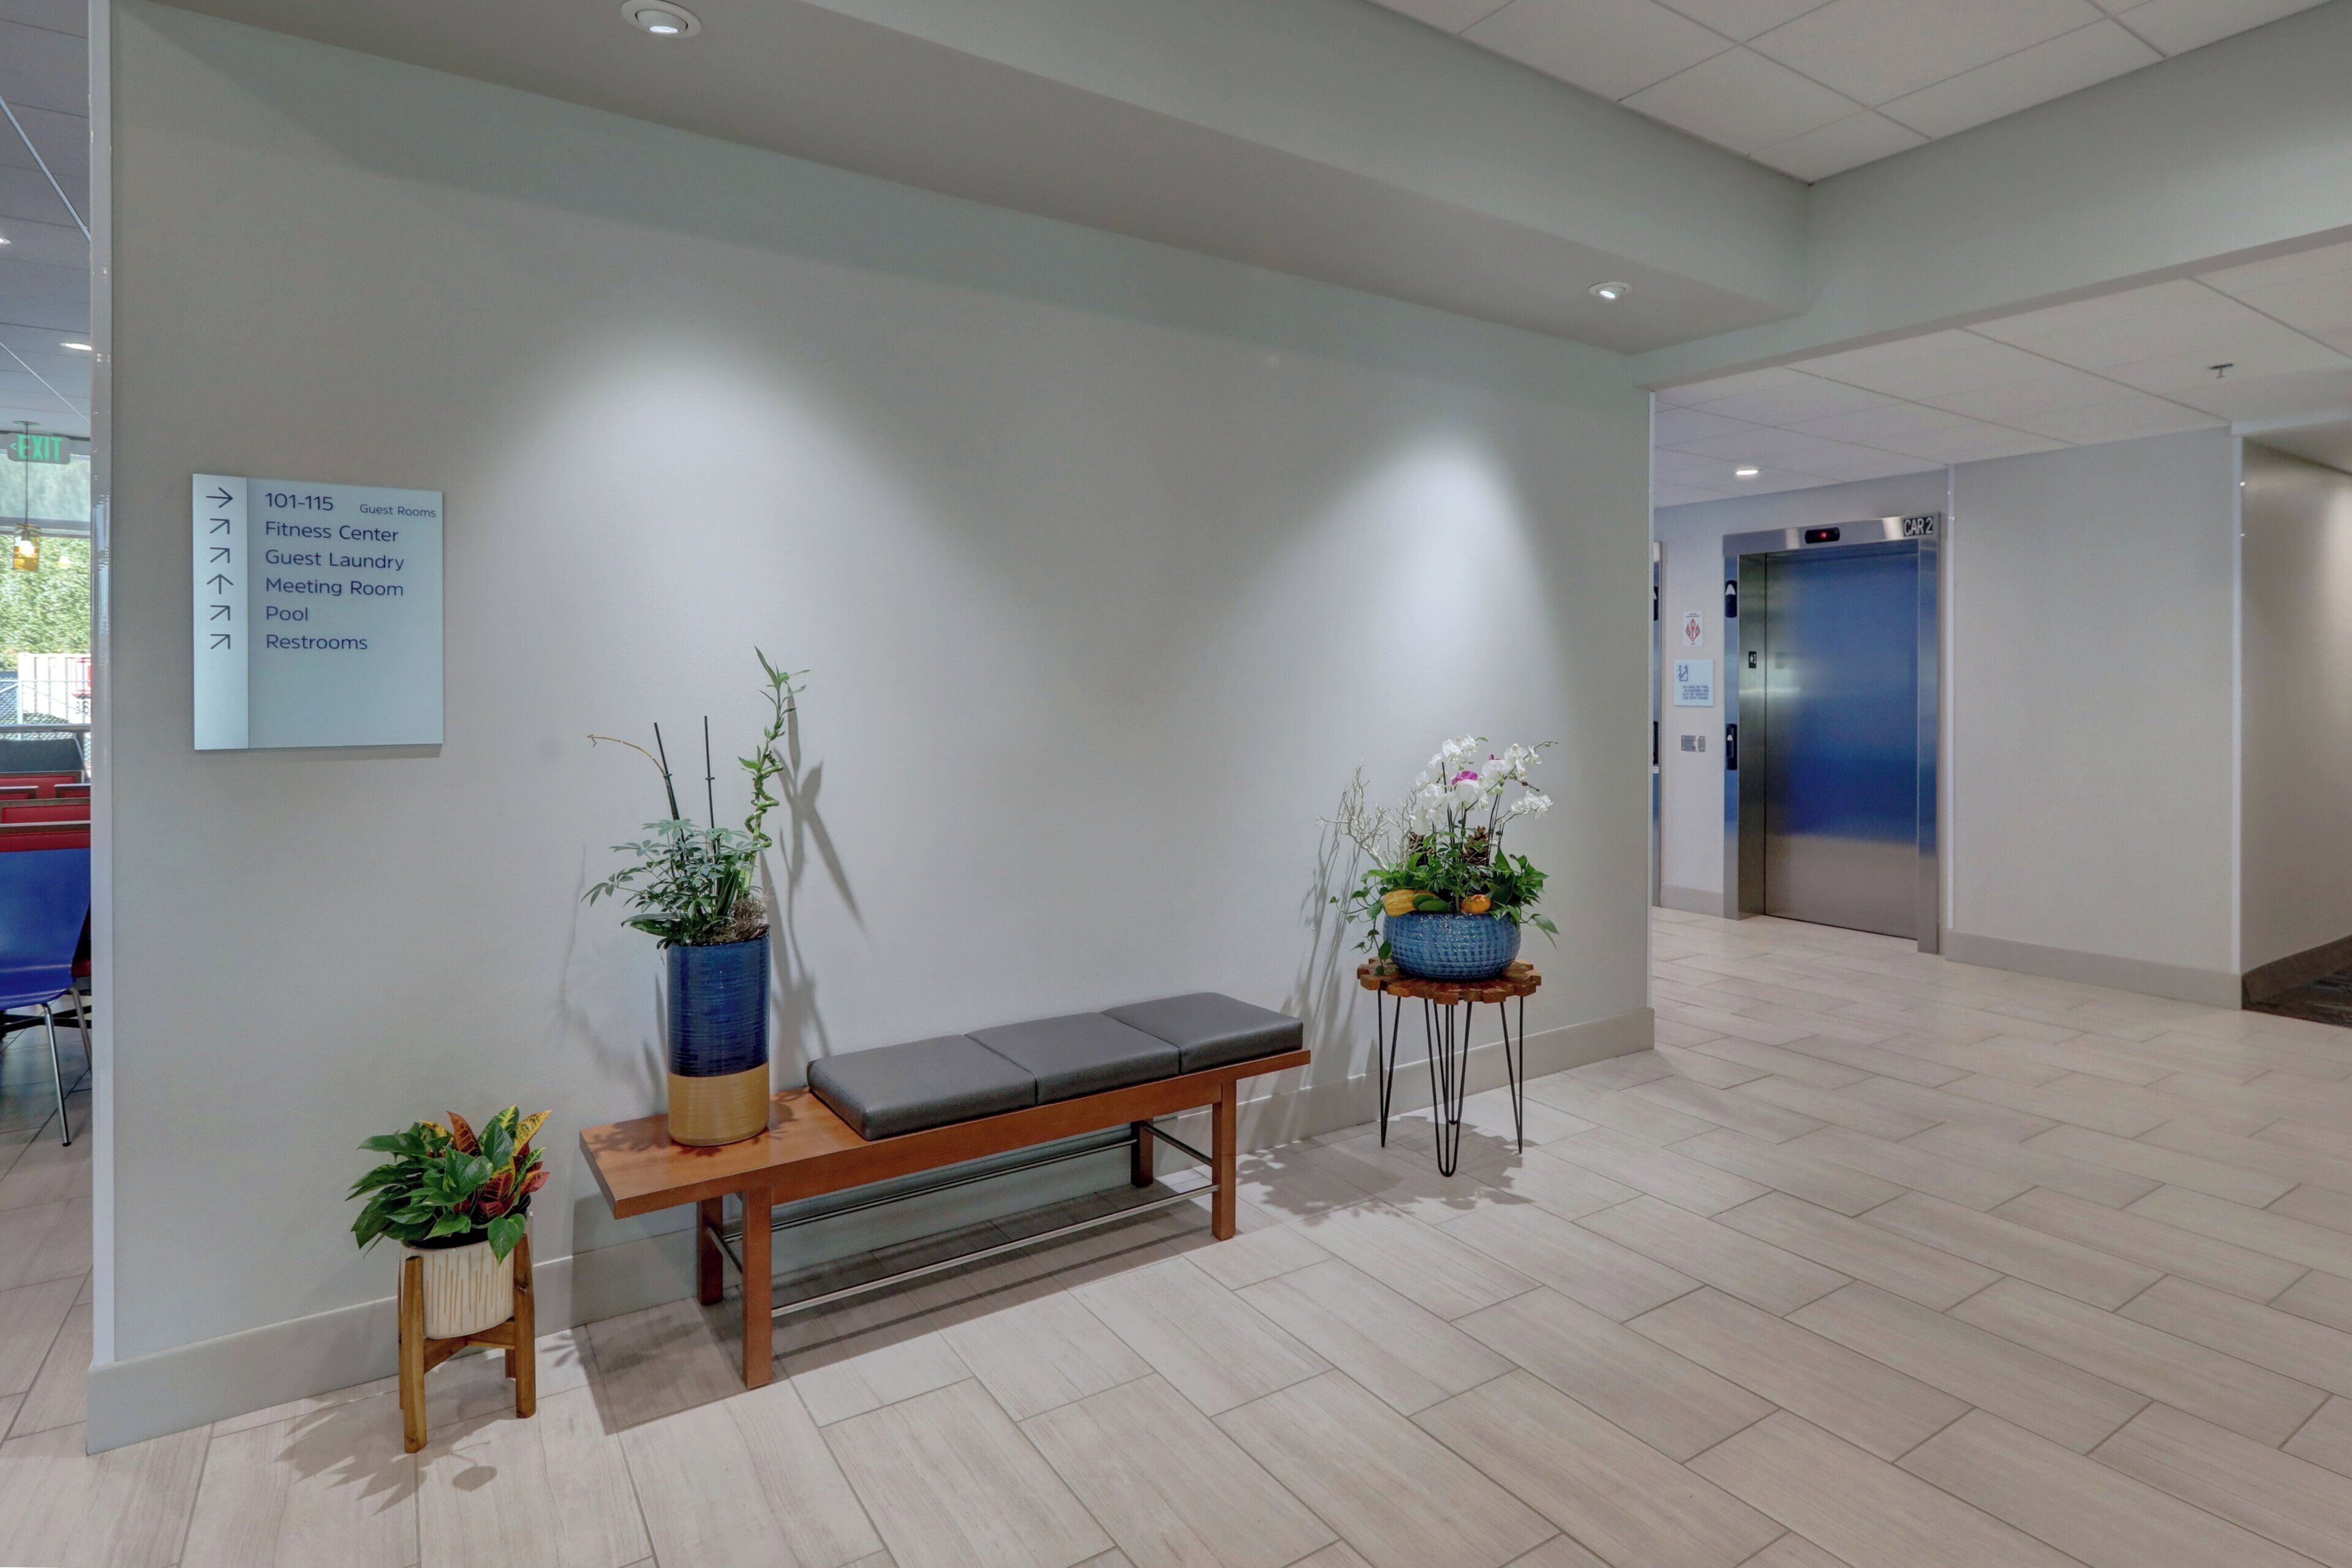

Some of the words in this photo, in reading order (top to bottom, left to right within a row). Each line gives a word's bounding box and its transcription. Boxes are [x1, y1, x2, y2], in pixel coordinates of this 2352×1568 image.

[17, 434, 63, 461] EXIT
[265, 492, 334, 511] 101-115
[359, 503, 394, 515] Guest
[397, 507, 437, 518] Rooms
[265, 521, 332, 538] Fitness
[339, 525, 399, 542] Center
[1904, 518, 1924, 536] CAR
[1925, 517, 1933, 534] 2
[265, 549, 322, 566] Guest
[329, 552, 404, 571] Laundry
[266, 577, 342, 597] Meeting
[350, 580, 404, 597] Room
[266, 605, 308, 622] Pool
[266, 634, 368, 650] Restrooms
